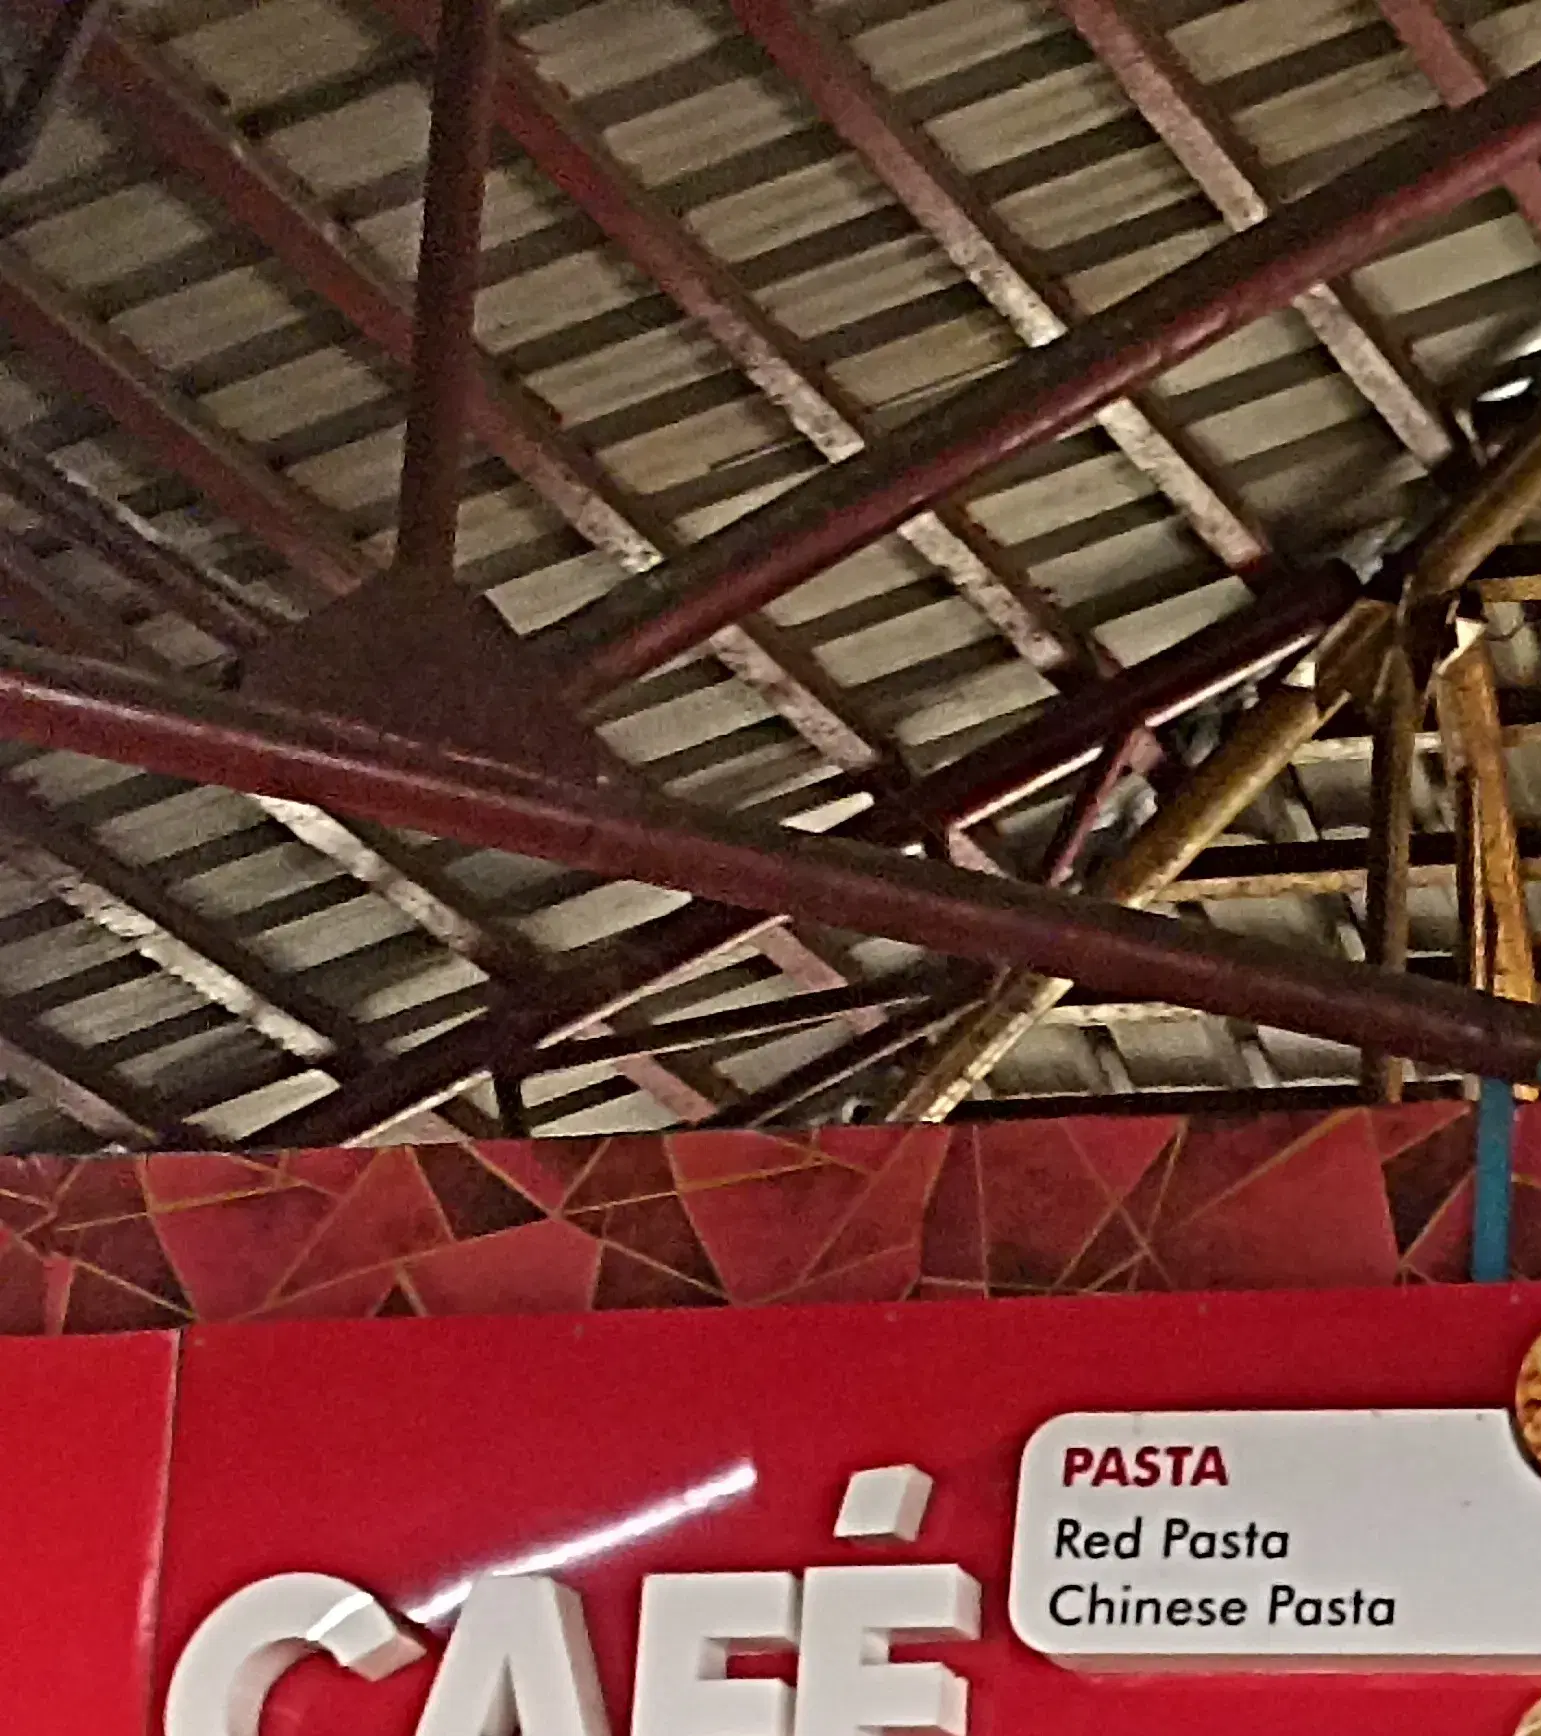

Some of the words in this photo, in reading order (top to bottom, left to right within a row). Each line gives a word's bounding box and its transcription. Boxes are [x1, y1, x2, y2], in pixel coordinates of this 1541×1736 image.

[1062, 1445, 1229, 1488] PASTA
[1055, 1515, 1143, 1560] Red
[1163, 1517, 1290, 1560] Pasta
[1049, 1582, 1248, 1627] Chinese
[1268, 1584, 1395, 1627] Pasta
